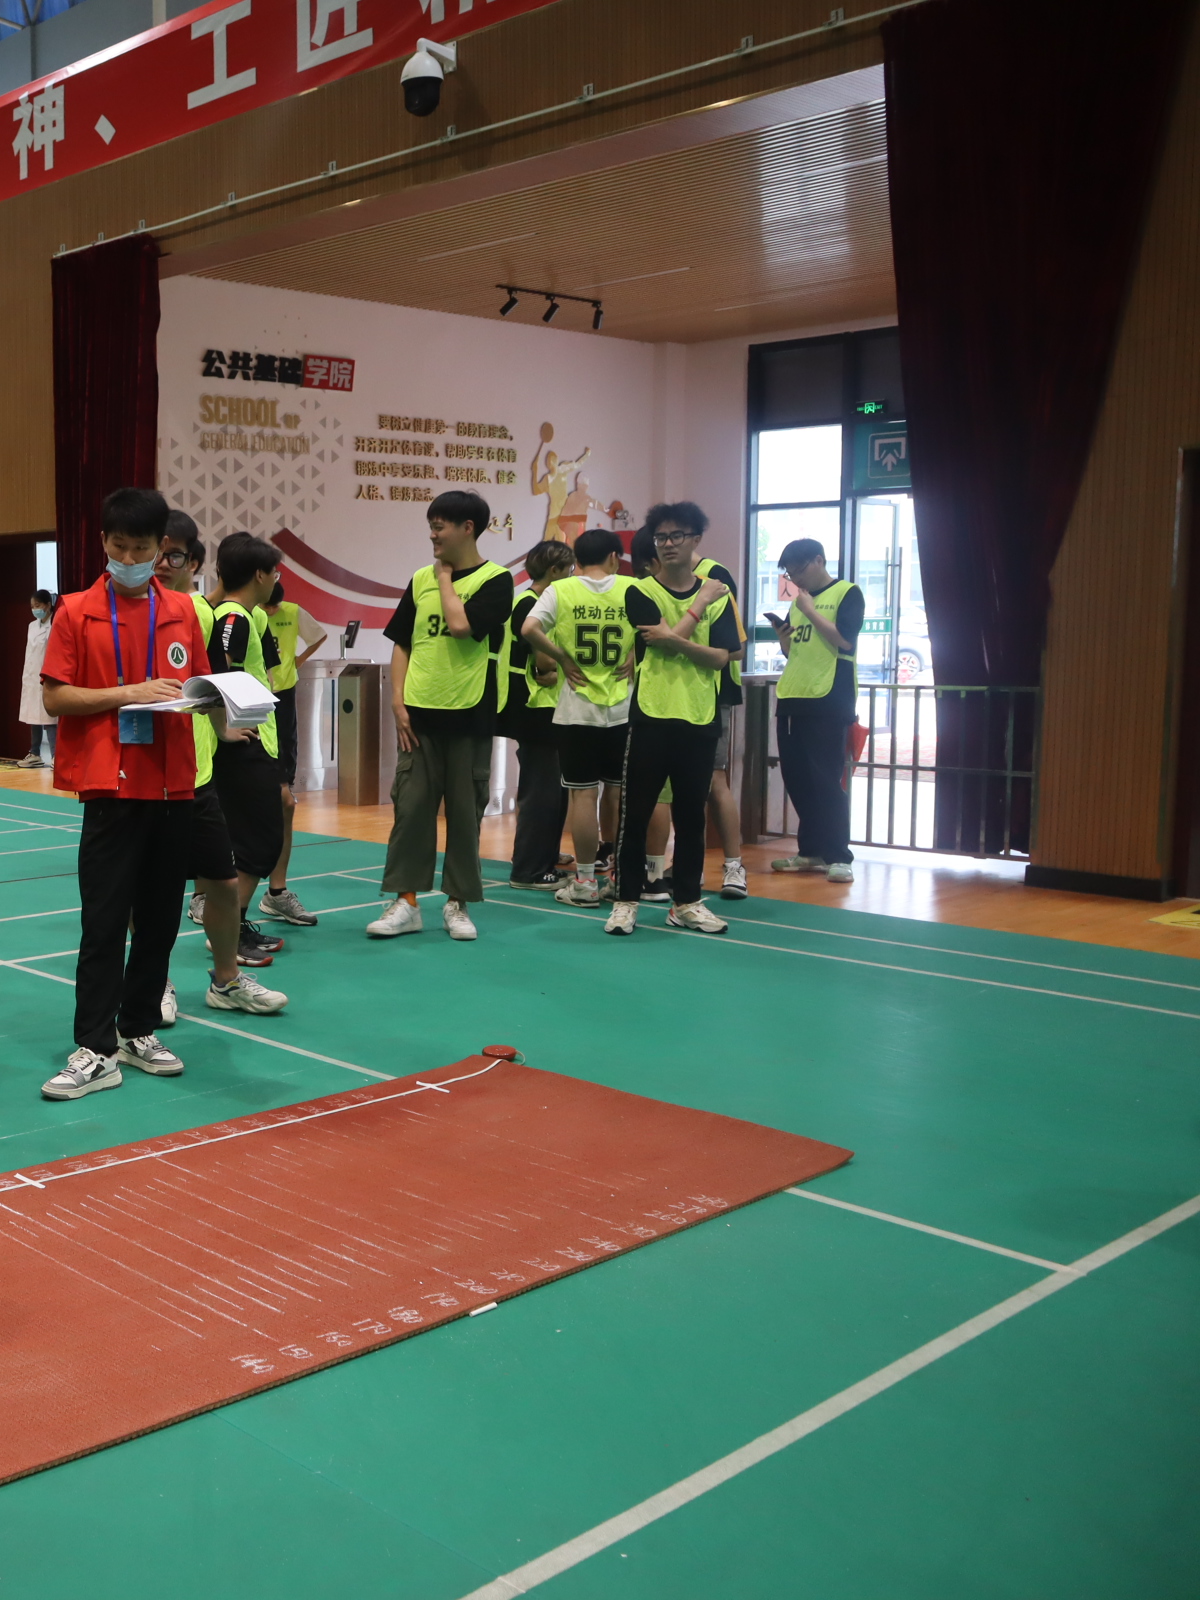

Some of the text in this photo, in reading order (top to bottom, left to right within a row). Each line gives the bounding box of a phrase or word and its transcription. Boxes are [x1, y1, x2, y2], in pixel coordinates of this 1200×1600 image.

[202, 349, 353, 389] 公共基础学院
[200, 394, 281, 428] SCHOOL
[201, 431, 311, 455] GENERAL EDUCATION
[574, 623, 623, 668] 56
[793, 624, 812, 643] 30
[351, 1318, 393, 1336] 170
